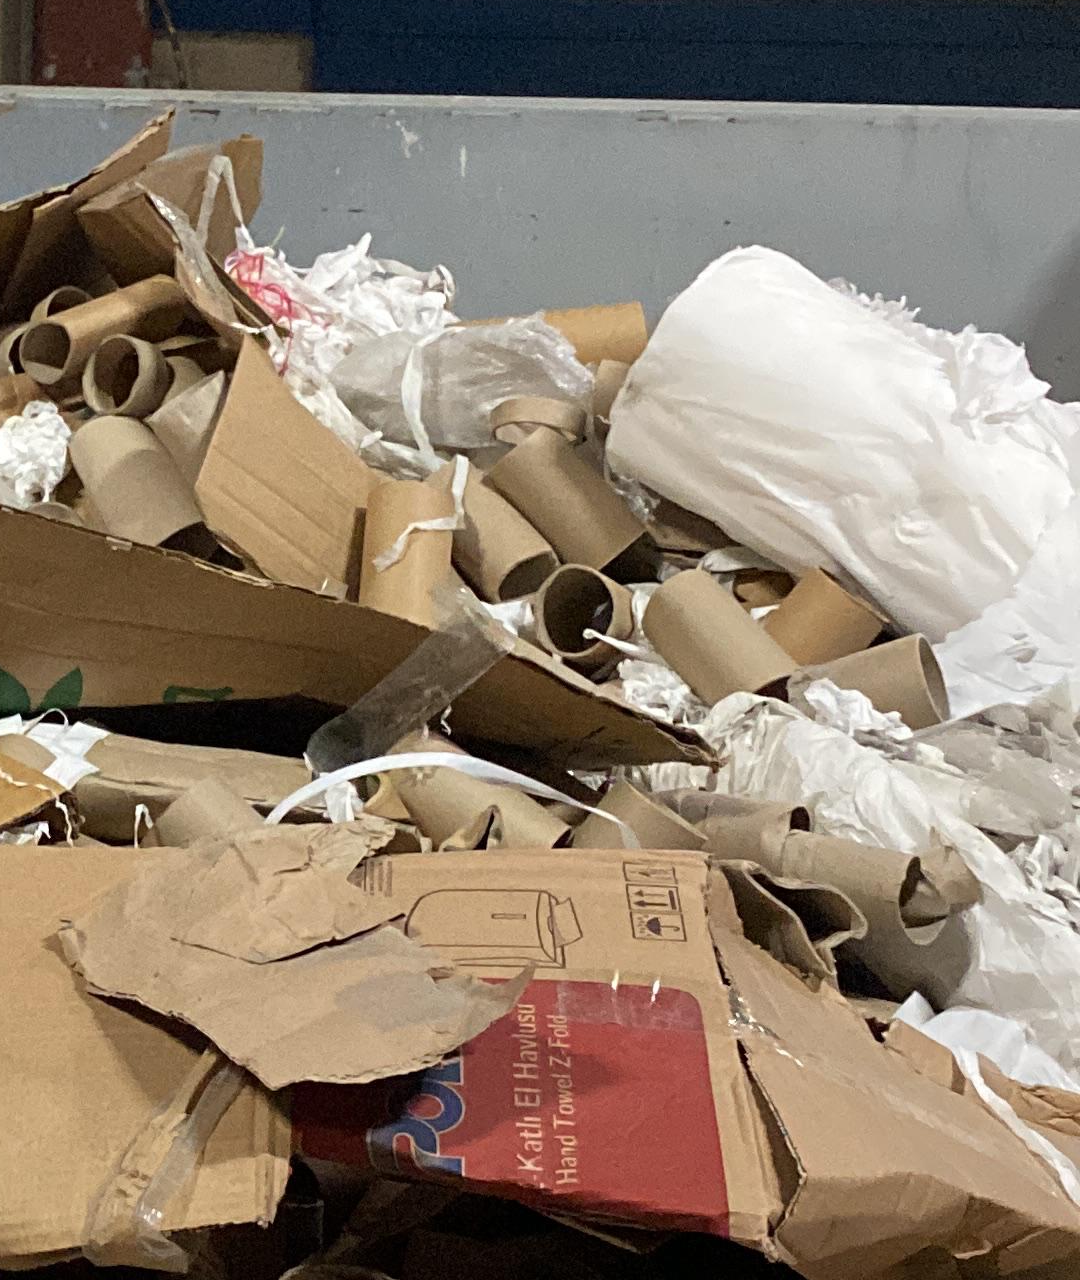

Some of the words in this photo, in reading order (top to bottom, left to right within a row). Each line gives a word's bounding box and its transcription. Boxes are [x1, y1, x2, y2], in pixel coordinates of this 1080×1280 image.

[511, 1003, 540, 1080] Havlusu
[546, 1014, 572, 1069] Z-Fold
[514, 1086, 542, 1109] El
[550, 1073, 577, 1131] Towel
[515, 1115, 545, 1189] -Katlı
[554, 1134, 579, 1186] Hand
